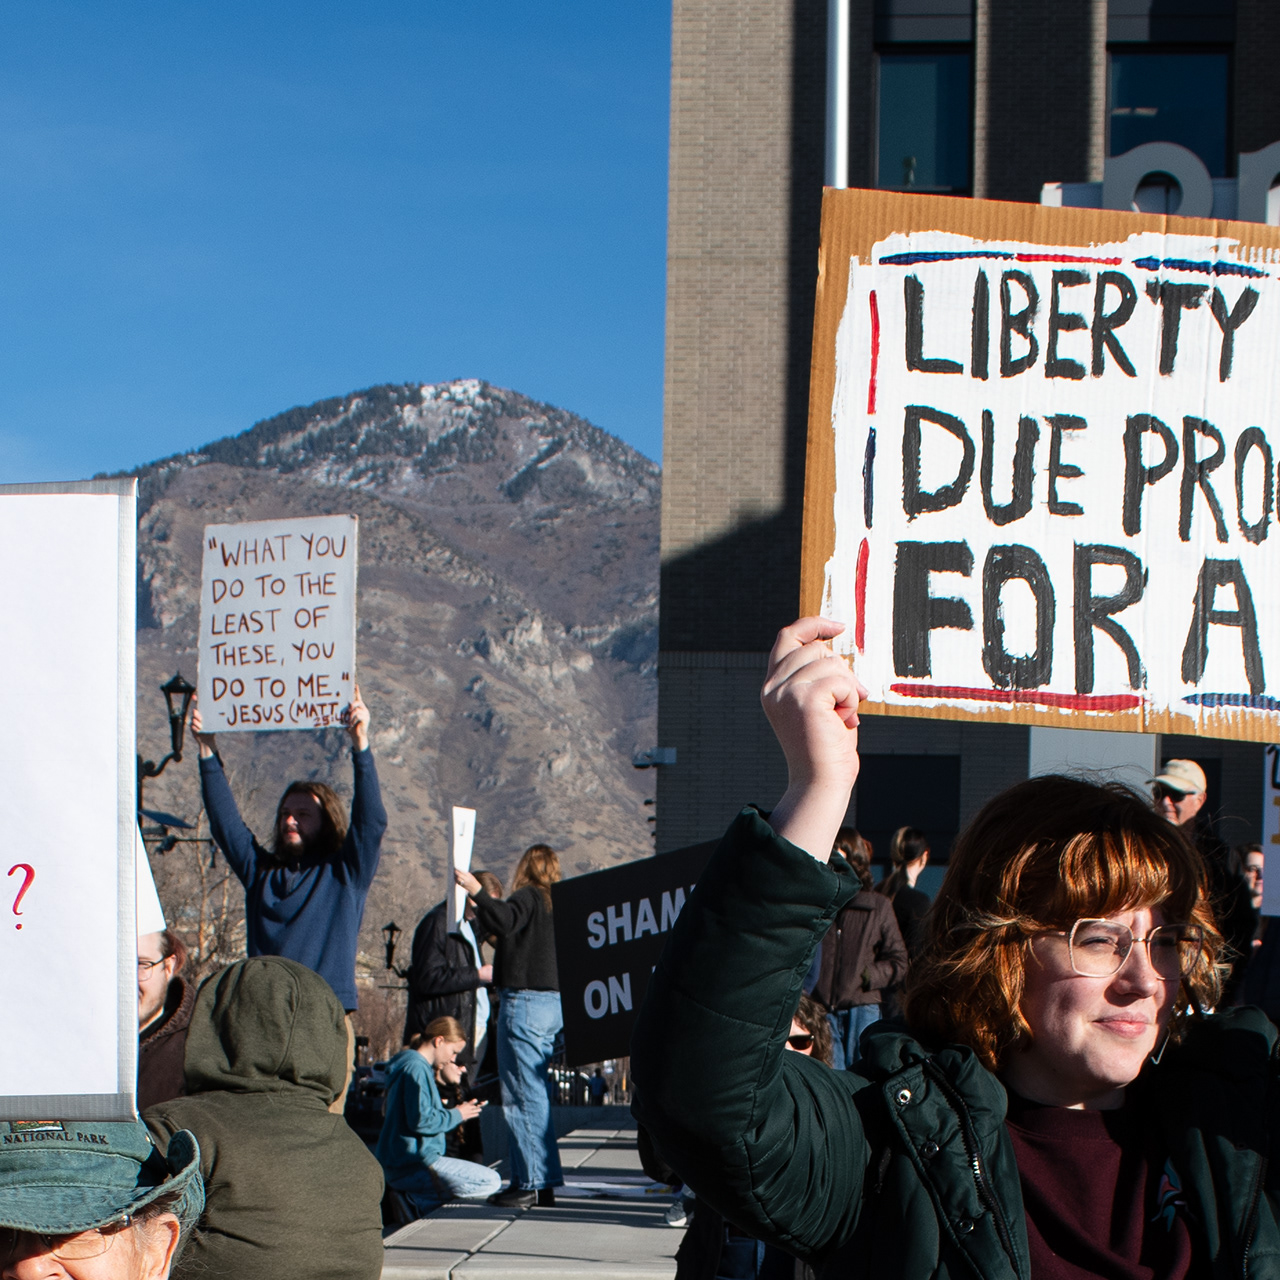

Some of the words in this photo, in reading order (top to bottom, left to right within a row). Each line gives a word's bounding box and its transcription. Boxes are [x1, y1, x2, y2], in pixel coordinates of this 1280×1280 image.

[903, 268, 1260, 382] LIBERTY
[901, 404, 1088, 526] DUE
[301, 533, 347, 560] YOU
[212, 579, 244, 604] DO
[255, 574, 286, 597] TO
[294, 572, 337, 597] THE
[211, 608, 282, 635] LEAST
[294, 605, 330, 629] OF
[891, 540, 1150, 696] FOR
[210, 642, 285, 667] THESE,
[292, 639, 335, 662] YOU
[212, 677, 245, 701] DO
[254, 676, 286, 698] TO
[587, 884, 696, 949] SHAM
[583, 972, 634, 1020] ON
[4, 1132, 74, 1145] NATIONAL
[76, 1132, 109, 1145] PARK
